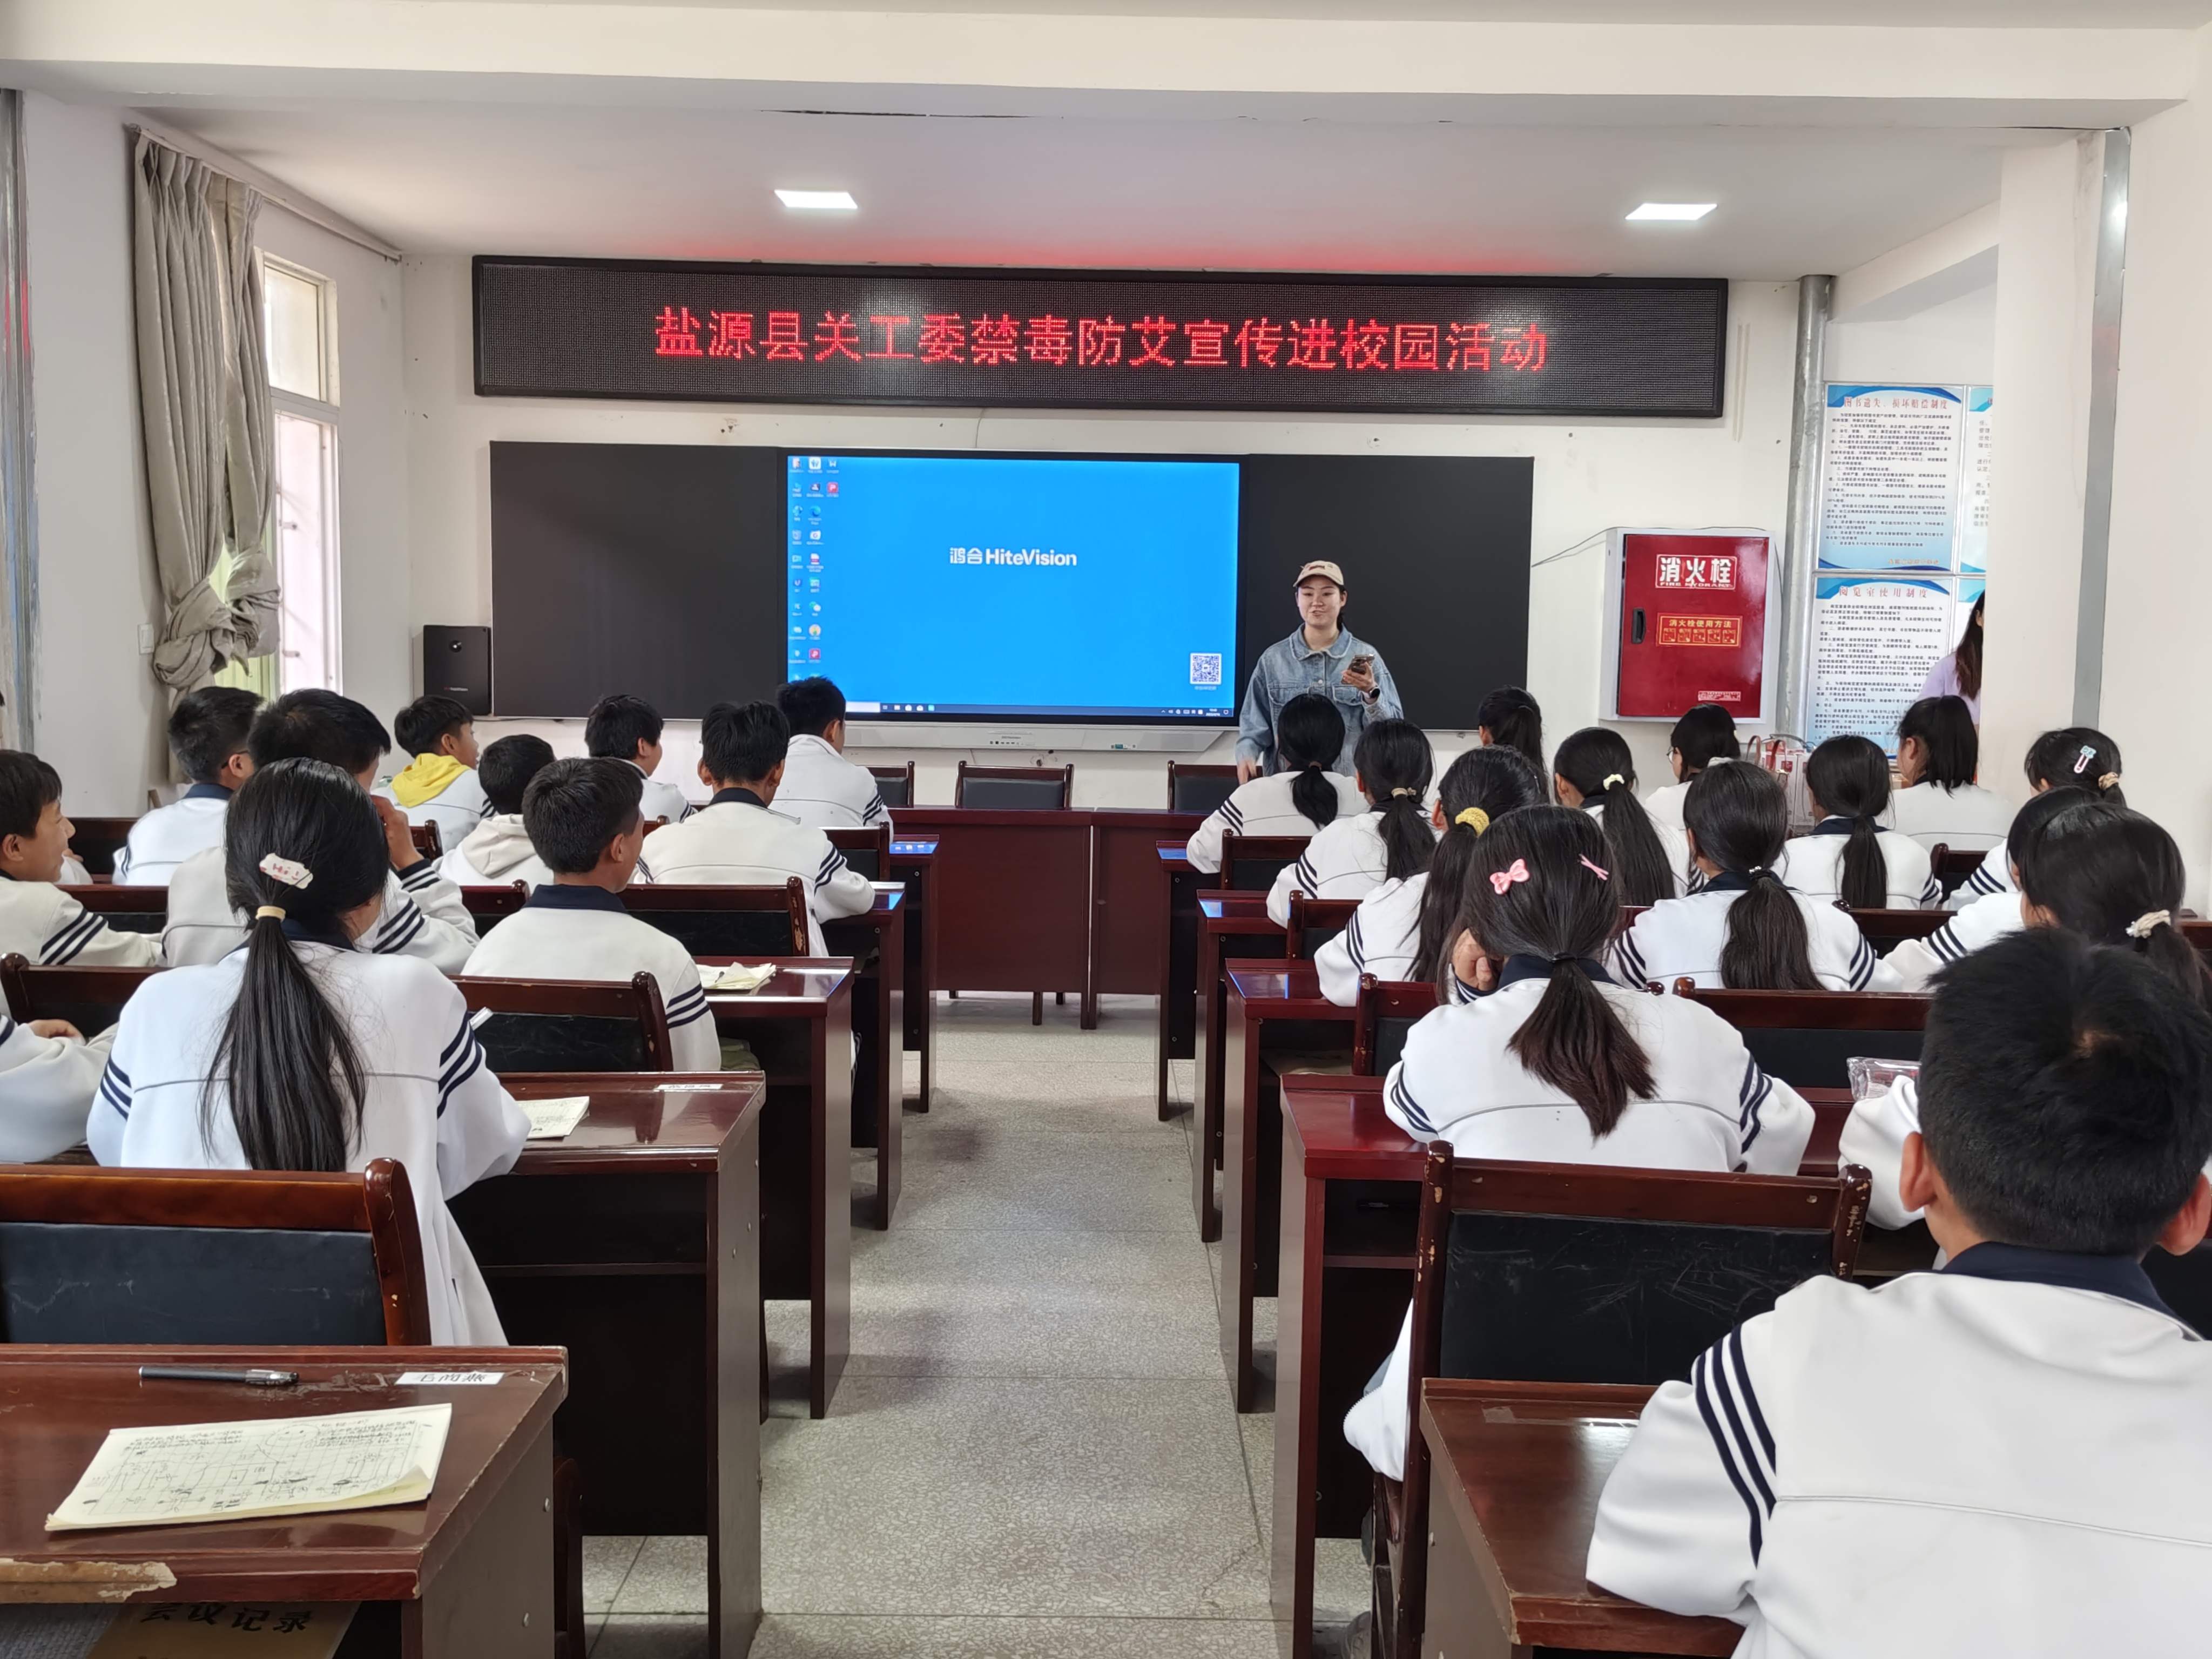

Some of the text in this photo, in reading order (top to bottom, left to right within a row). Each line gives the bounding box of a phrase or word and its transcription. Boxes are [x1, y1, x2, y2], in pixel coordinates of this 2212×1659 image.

[655, 306, 1548, 373] 盐源县关工委禁毒防艾宣传进校园活动
[949, 547, 1077, 567] 鸿合 HiteVision
[1659, 557, 1732, 583] 消火栓
[1839, 586, 1928, 598] 阅览室使用制度
[1669, 619, 1732, 628] 消火栓使用方法
